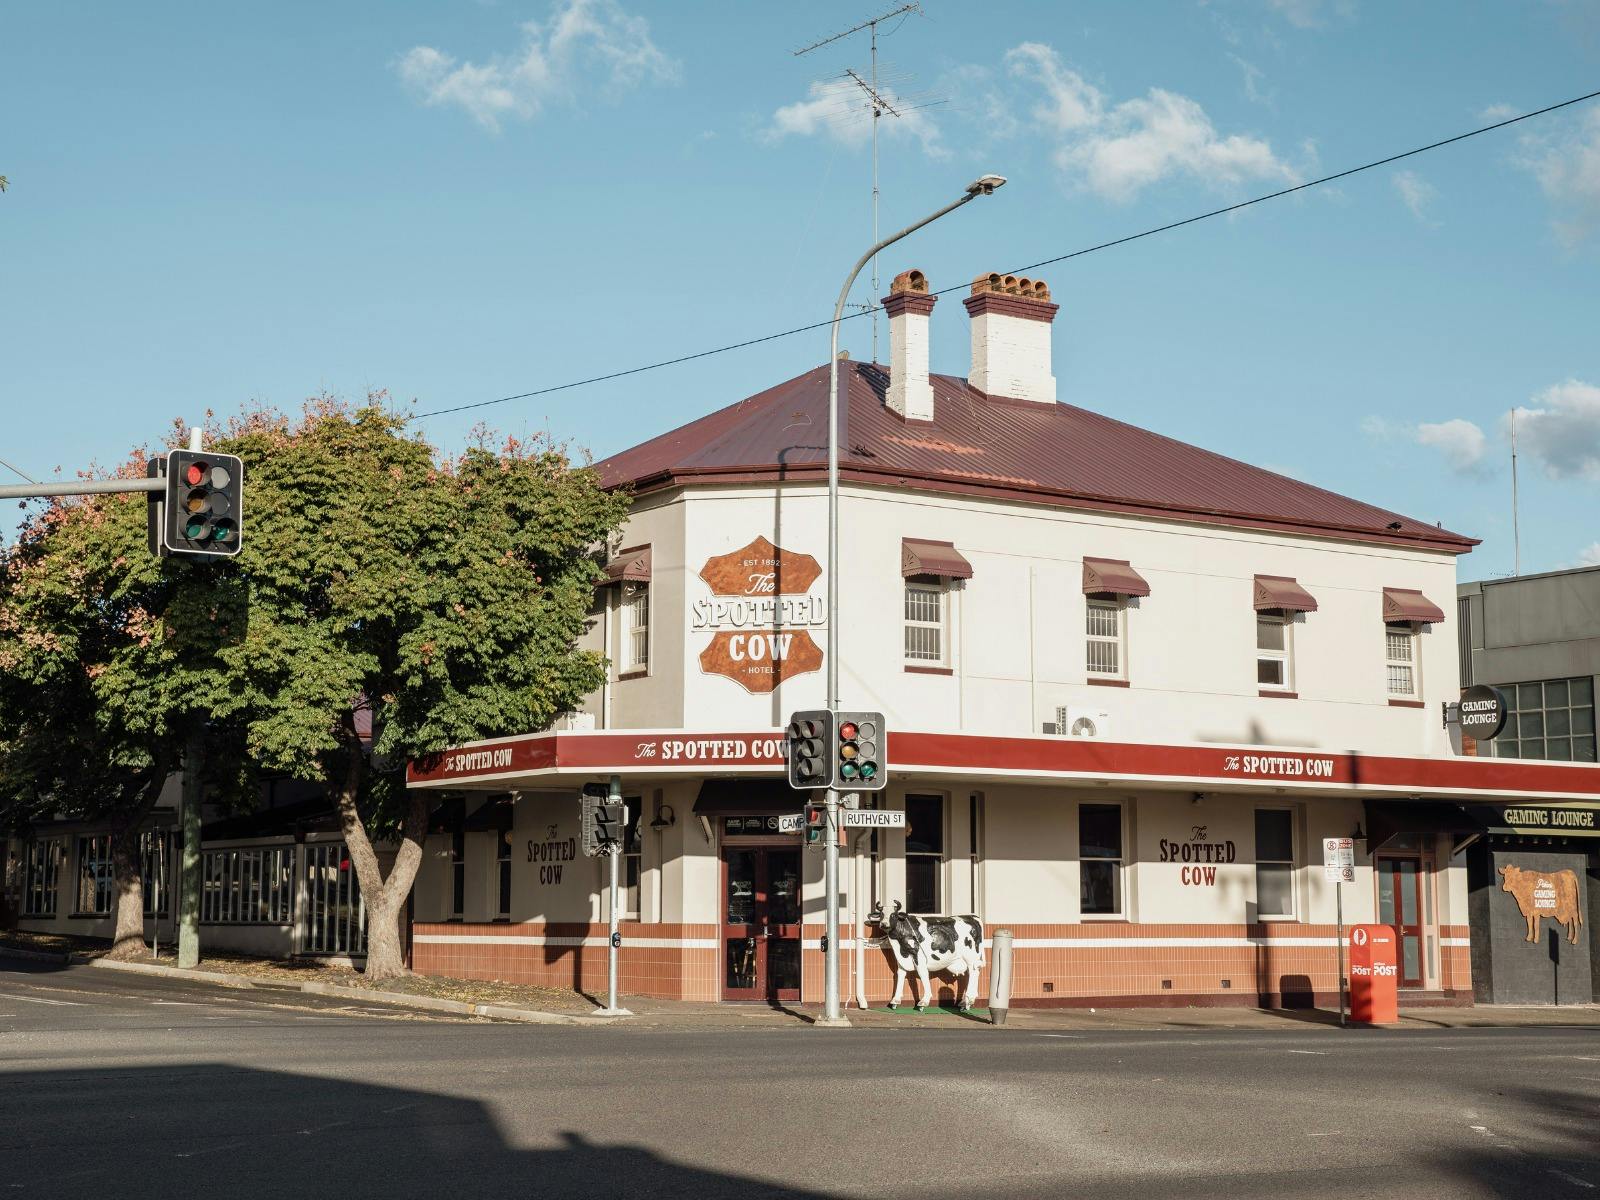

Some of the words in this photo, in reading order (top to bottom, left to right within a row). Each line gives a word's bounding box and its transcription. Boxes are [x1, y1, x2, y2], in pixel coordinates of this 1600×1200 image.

[743, 559, 758, 567] EST
[761, 559, 780, 567] 1892
[744, 573, 776, 594] The
[692, 595, 827, 628] SPOTTED
[729, 634, 793, 661] COW
[748, 666, 775, 674] HOTEL
[1461, 700, 1497, 712] GAMING
[1462, 713, 1497, 725] LOUNGE
[444, 756, 455, 772] The
[455, 751, 493, 772] SPOTTED
[494, 748, 513, 768] COW
[634, 742, 656, 759] The
[662, 740, 747, 760] SPOTTED
[751, 739, 789, 758] COW
[1223, 756, 1240, 771] The
[1243, 756, 1304, 775] SPOTTED
[1306, 758, 1334, 777] COW
[847, 813, 890, 825] RUTHVEN
[893, 814, 902, 823] ST
[1503, 809, 1548, 825] GAMING
[1551, 811, 1594, 827] LOUNGE
[1189, 825, 1207, 842] The
[527, 837, 576, 863] SPOTTED
[1159, 838, 1236, 863] SPOTTED
[540, 864, 563, 885] COW
[1181, 865, 1217, 886] COW
[1352, 967, 1371, 976] POST
[1374, 965, 1397, 976] POST
